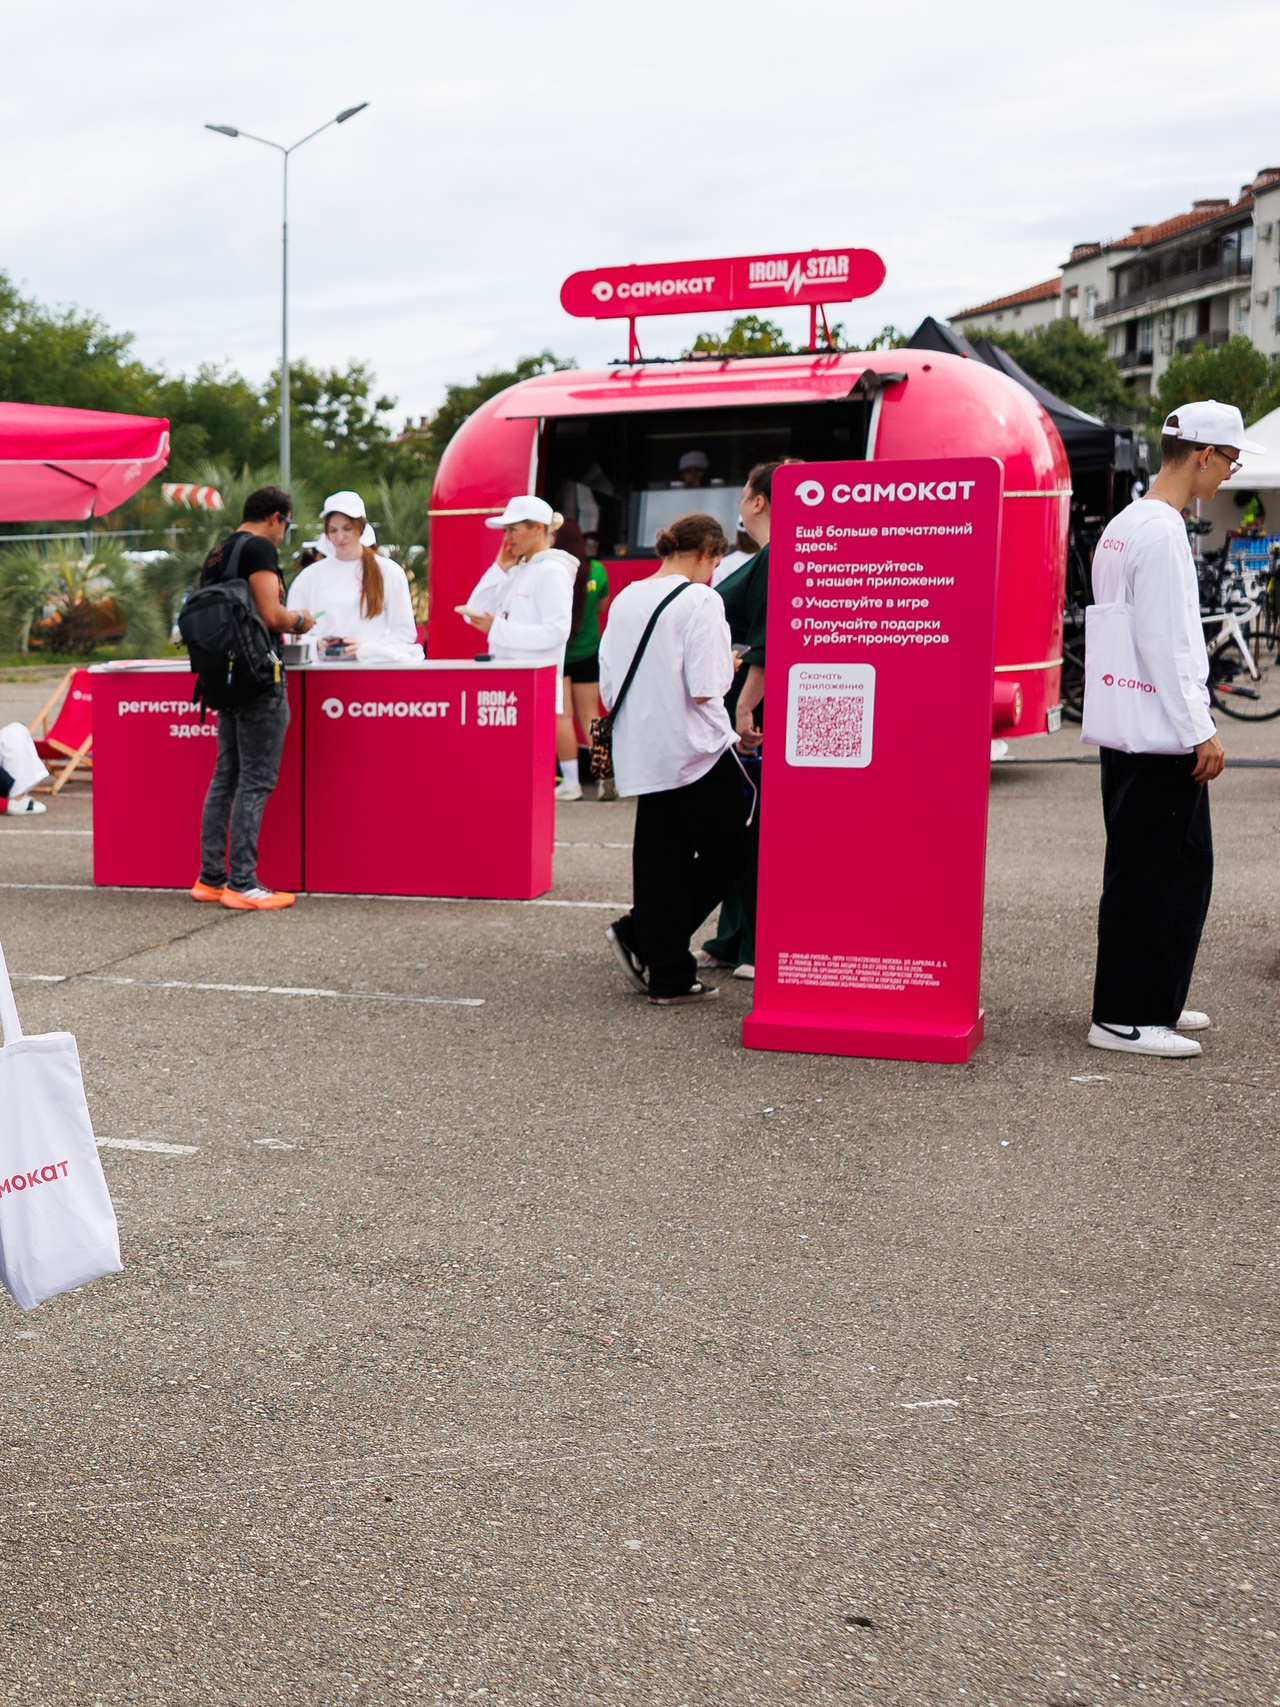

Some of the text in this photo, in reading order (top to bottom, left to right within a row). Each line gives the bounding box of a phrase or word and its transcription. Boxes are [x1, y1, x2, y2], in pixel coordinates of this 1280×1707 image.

[749, 255, 850, 282] IRON STAR
[617, 277, 715, 298] самокат
[831, 480, 976, 503] самокат
[796, 522, 973, 539] Ещё больше впечатлений
[795, 542, 837, 553] здесь:
[807, 560, 924, 575] Регистрируйтесь
[806, 576, 955, 589] в нашем приложении
[805, 596, 883, 611] Участвуйте
[886, 598, 894, 608] в
[897, 598, 929, 611] игре
[804, 617, 878, 632] Получайте
[881, 620, 941, 632] подарки
[803, 631, 950, 647] у ребят-промоутеров
[799, 671, 842, 680] Скачать
[799, 683, 864, 691] приложение
[477, 691, 507, 706] IRON
[348, 702, 450, 717] самокат
[477, 706, 517, 726] STAR
